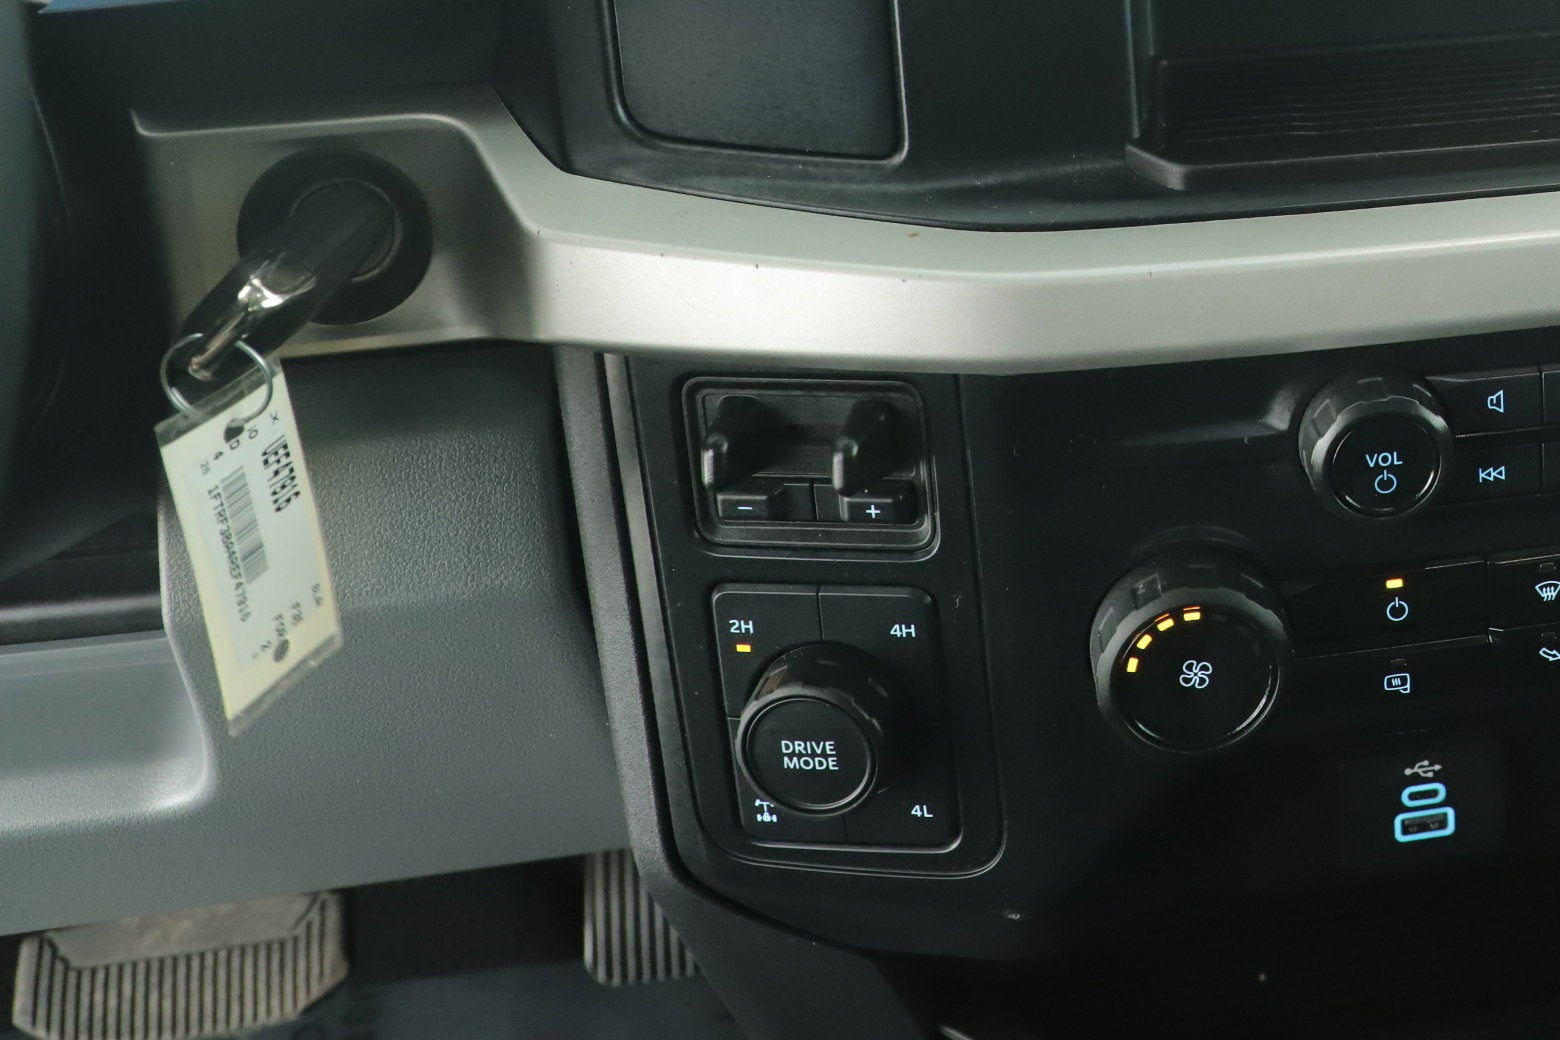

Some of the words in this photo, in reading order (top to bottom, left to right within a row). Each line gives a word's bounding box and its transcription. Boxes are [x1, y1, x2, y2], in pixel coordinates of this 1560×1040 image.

[1365, 451, 1403, 468] VOL
[728, 619, 754, 634] 2H
[889, 623, 916, 638] 4H
[781, 740, 836, 755] DRIVE
[783, 756, 839, 770] MODE
[910, 804, 934, 818] 4L
